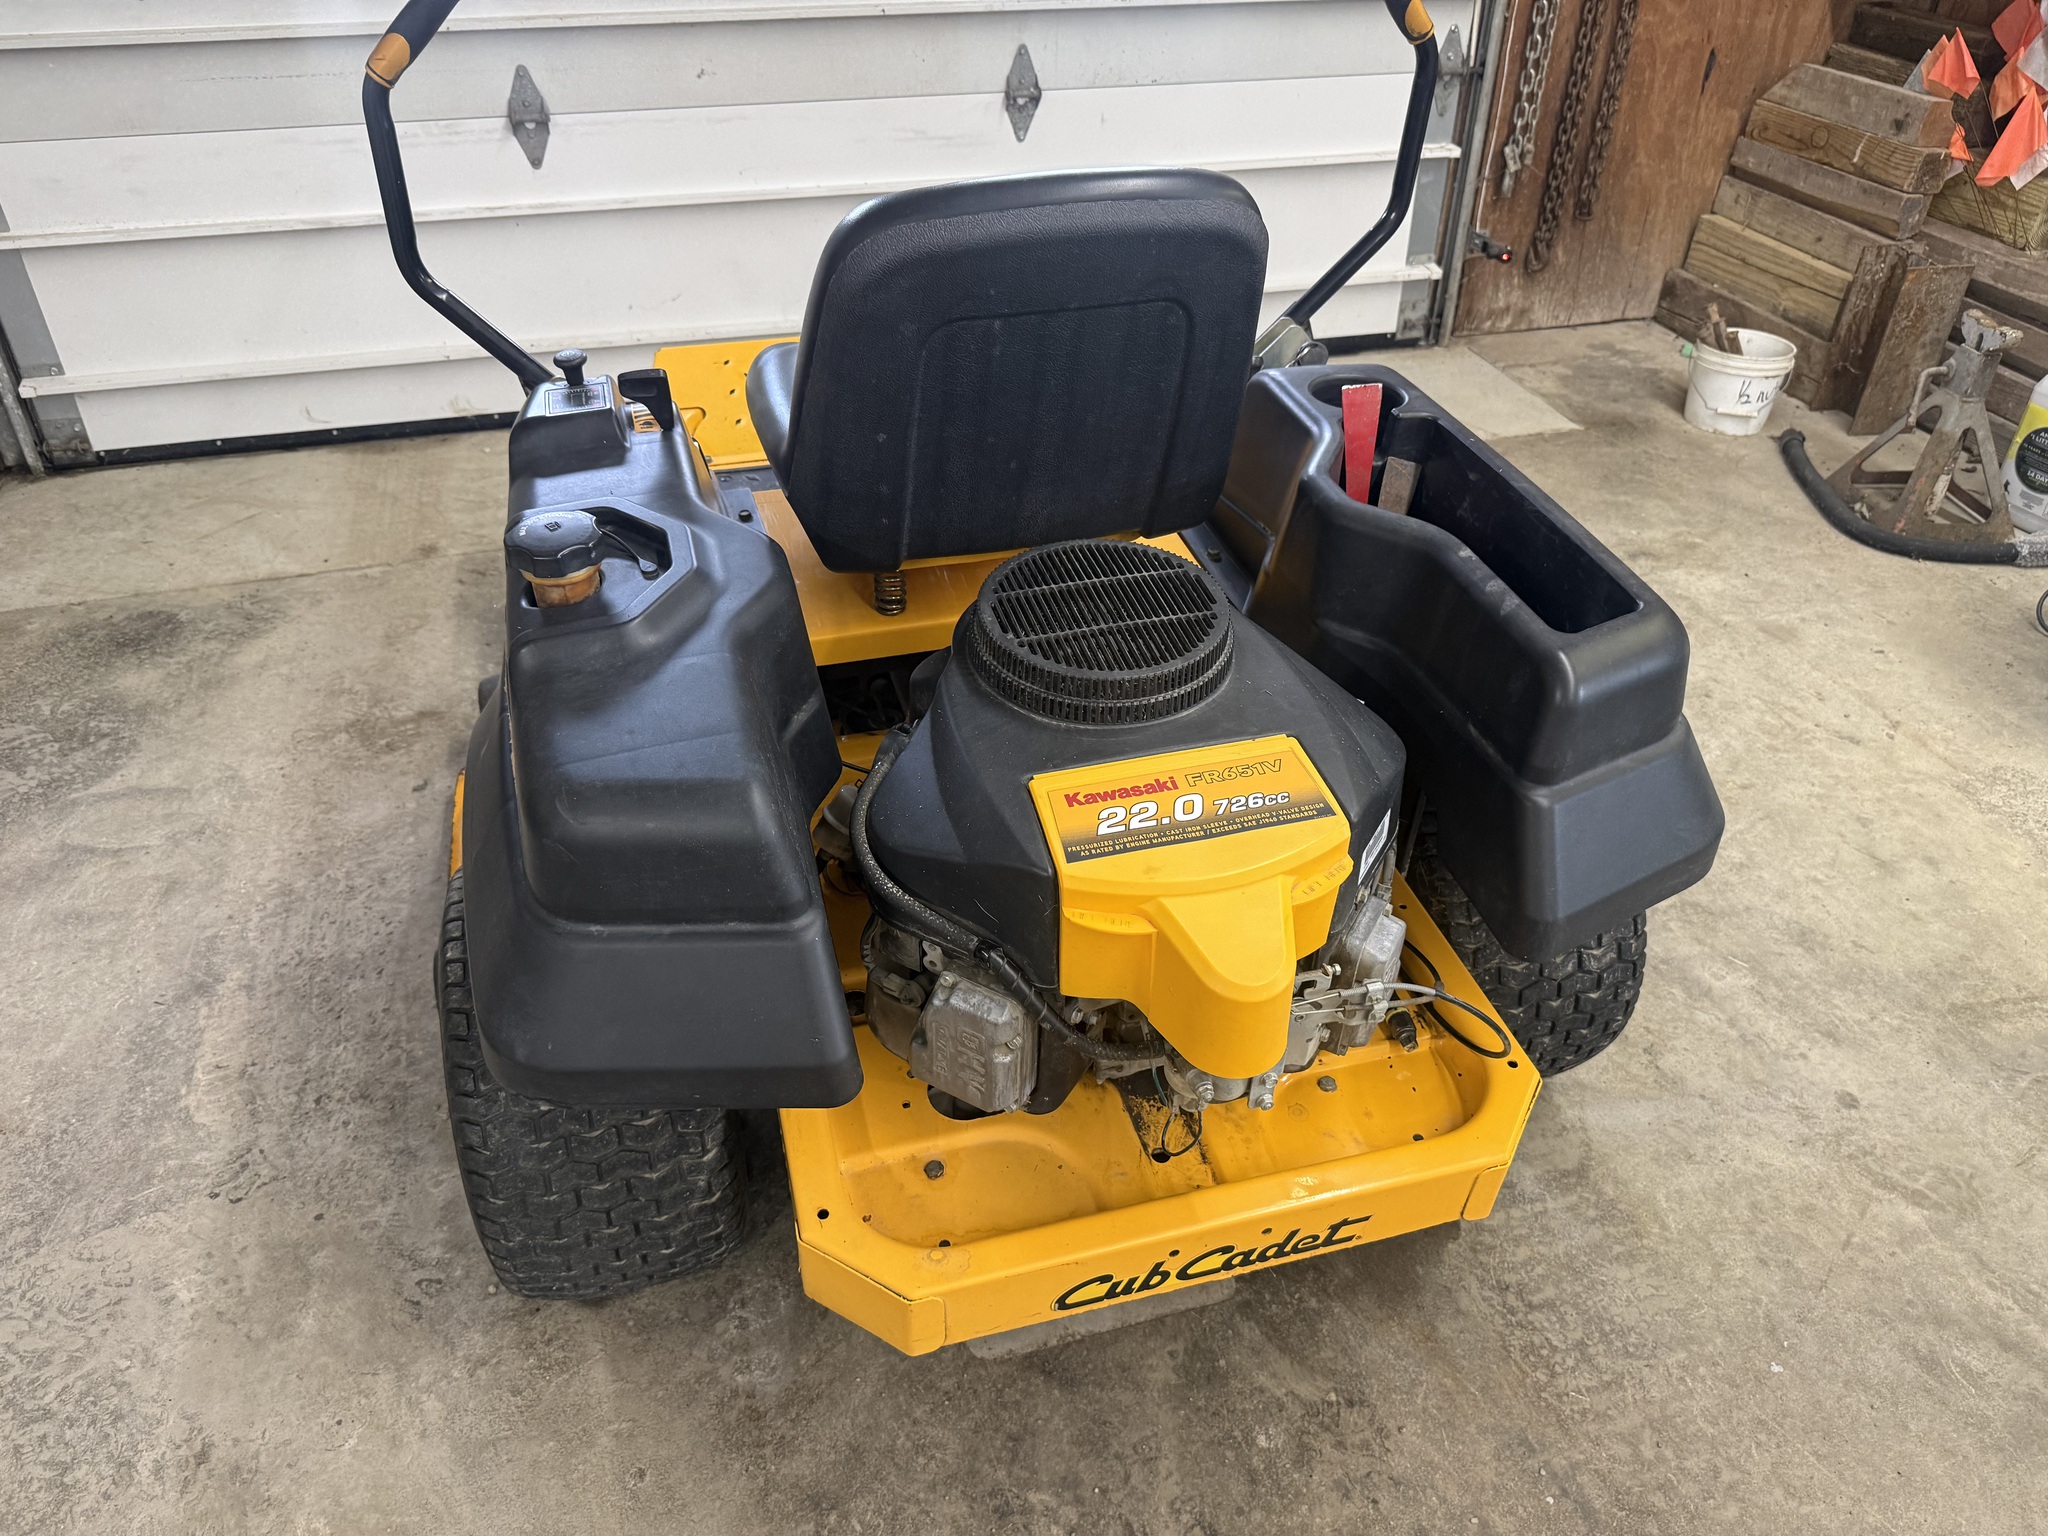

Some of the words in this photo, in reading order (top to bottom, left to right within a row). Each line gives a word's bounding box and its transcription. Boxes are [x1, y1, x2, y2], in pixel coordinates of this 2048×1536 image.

[1064, 776, 1179, 807] Kawasaki
[1185, 759, 1282, 787] FR651V
[1067, 840, 1114, 853] PRESSURIZED
[1115, 832, 1158, 844] LUBRICATION
[1166, 828, 1183, 836] CAST
[1185, 825, 1201, 834] IRON
[1203, 821, 1228, 830] SLEEVE
[1235, 812, 1270, 823] OVERHEAD
[1300, 802, 1325, 812] DESIGN
[1092, 846, 1114, 855] RATED
[1116, 843, 1125, 851] BY
[1126, 839, 1151, 849] ENGINE
[1152, 831, 1205, 844] MANUFACTURER
[1212, 823, 1242, 834] EXCEEDS
[1244, 820, 1257, 828] SAE
[1279, 810, 1318, 821] STANDARDS
[1097, 793, 1204, 836] 22.0
[1213, 792, 1290, 816] 726cc
[1054, 1260, 1171, 1311] Cub
[1175, 1214, 1373, 1281] Cadet
